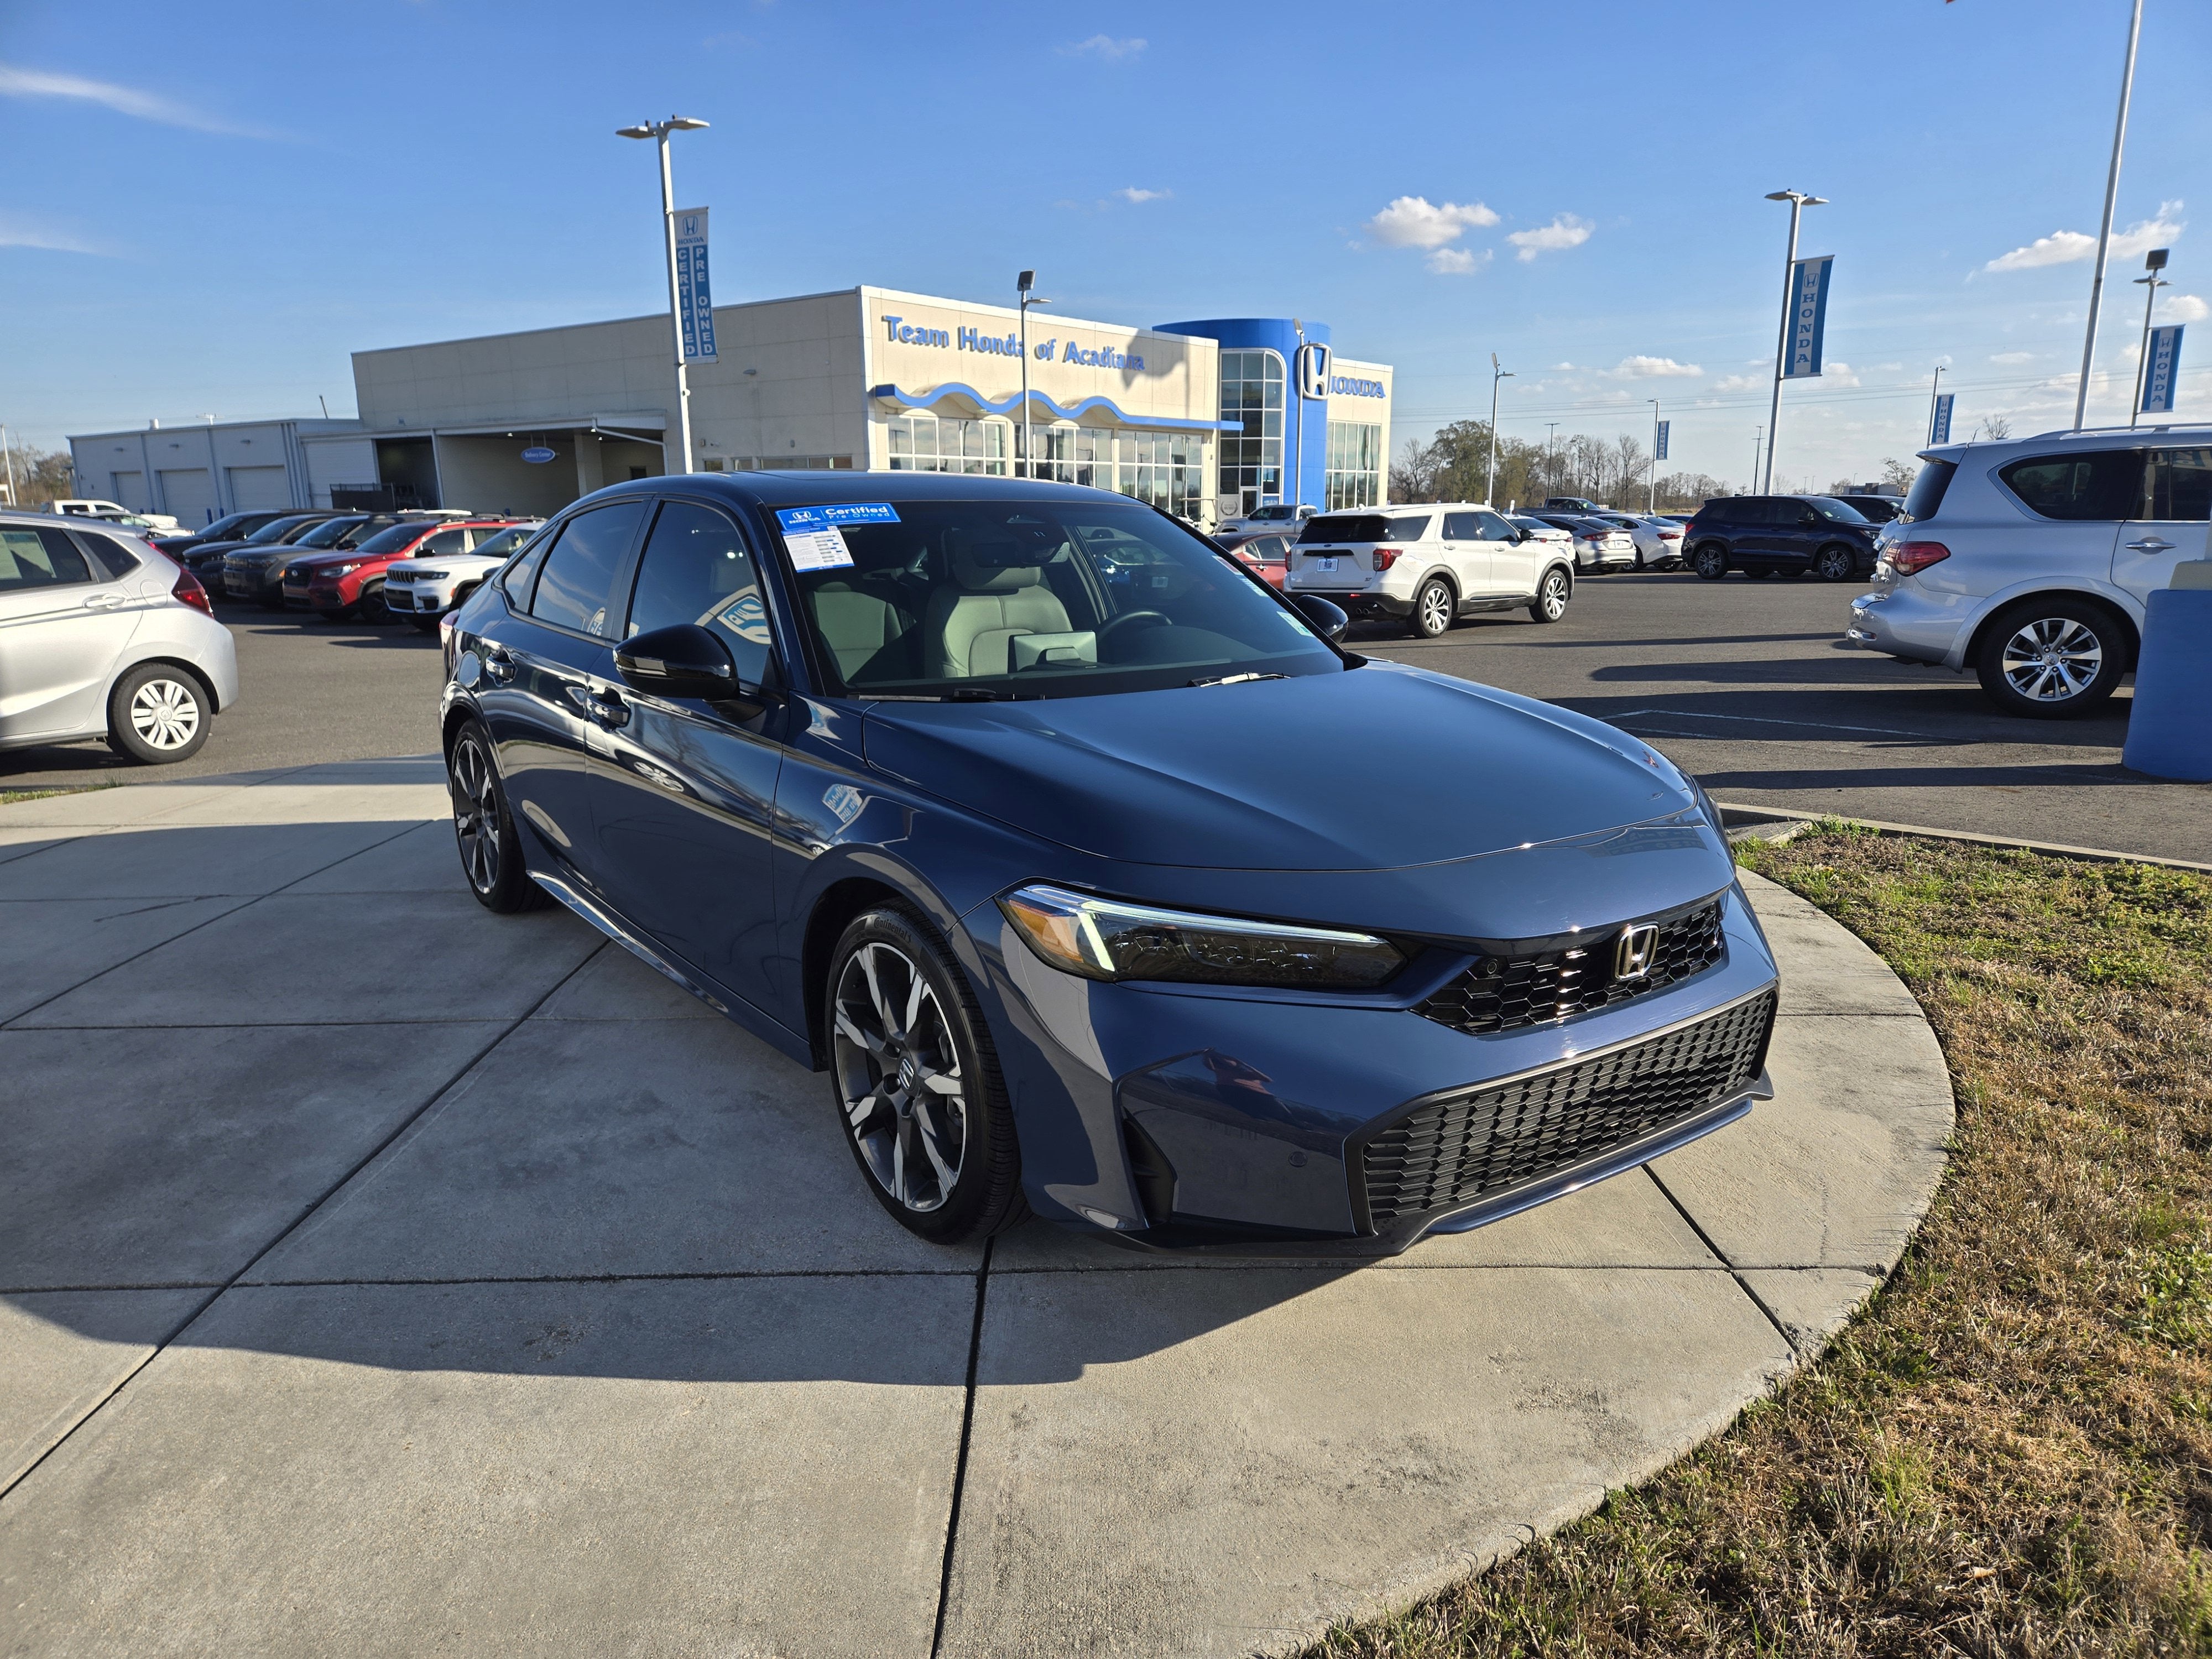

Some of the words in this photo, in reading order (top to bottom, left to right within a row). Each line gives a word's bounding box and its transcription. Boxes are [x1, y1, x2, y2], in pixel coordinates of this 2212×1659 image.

[677, 237, 704, 245] HONDA
[696, 248, 706, 282] PRE
[677, 250, 696, 355] CERTIFIED
[698, 295, 713, 353] OWNED
[881, 315, 950, 348] Team
[957, 326, 1026, 357] Honda
[1034, 338, 1057, 361] of
[1062, 341, 1145, 371] Acadiana
[1796, 293, 1816, 363] HONDA
[2152, 351, 2169, 402] HONDA
[1937, 409, 1947, 439] HONDA
[825, 506, 888, 515] Certified
[874, 916, 908, 940] Continental
